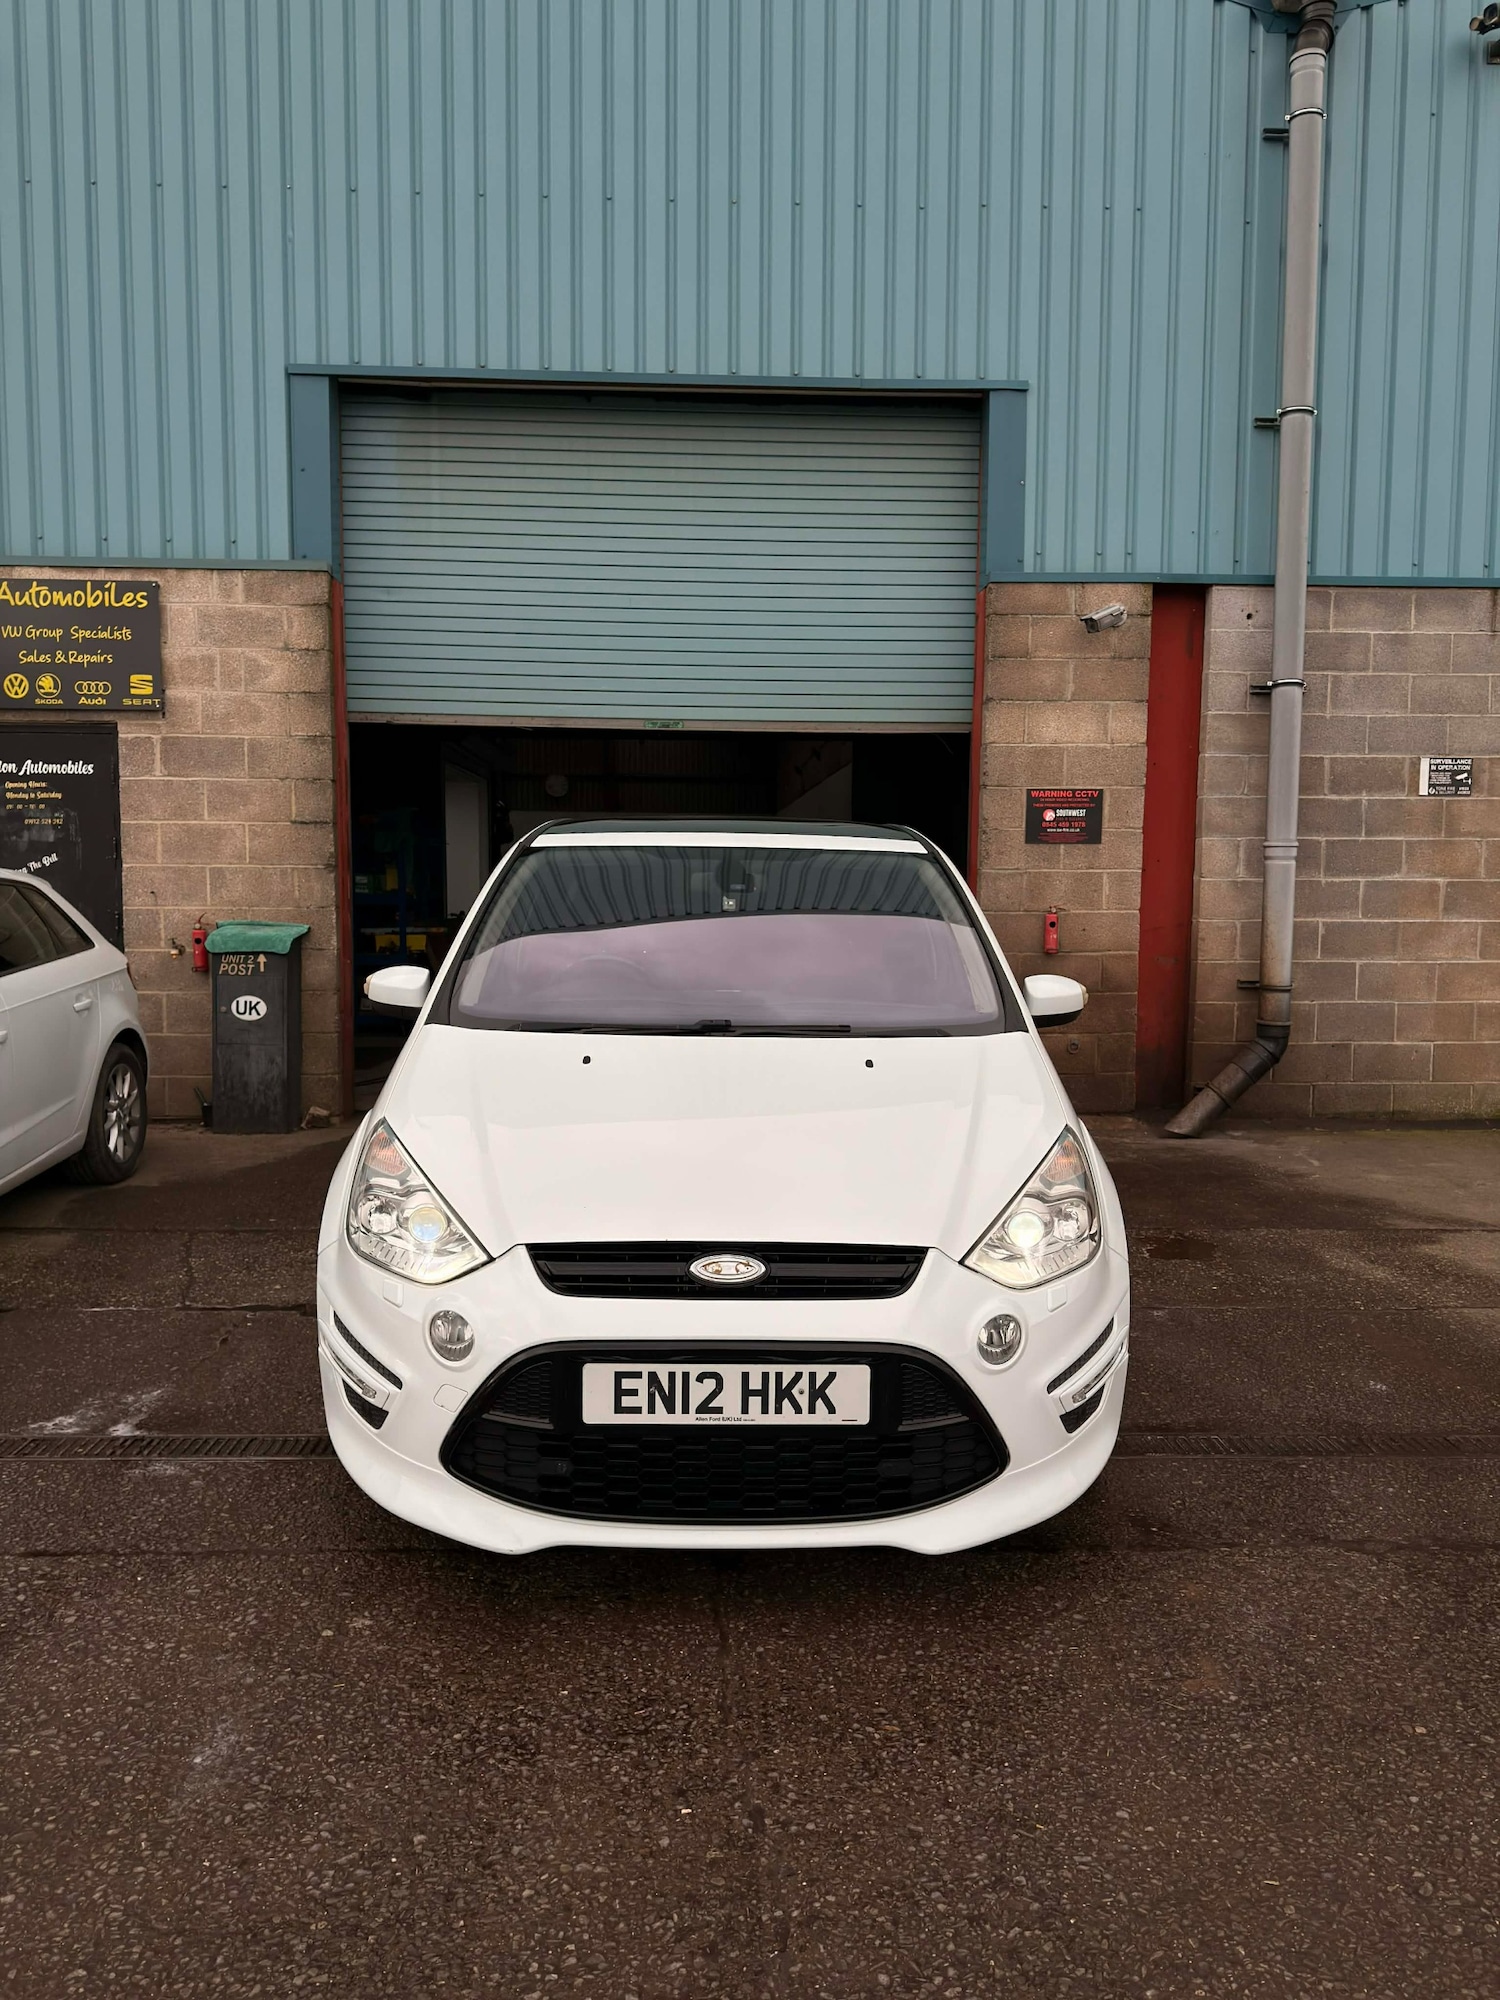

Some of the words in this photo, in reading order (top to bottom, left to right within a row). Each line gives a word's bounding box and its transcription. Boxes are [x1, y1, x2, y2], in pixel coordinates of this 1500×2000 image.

[0, 581, 148, 608] Automobiles
[1, 625, 23, 639] VW
[25, 625, 63, 642] Group
[70, 625, 132, 643] Specialists
[18, 650, 51, 664] Sales
[55, 650, 67, 663] &
[69, 650, 113, 668] Repairs
[78, 697, 106, 705] Audi
[122, 698, 161, 706] SEAT
[18, 759, 94, 776] Automobiles
[1030, 790, 1073, 798] WARNING
[1075, 790, 1099, 798] CCTV
[1056, 809, 1086, 817] SOUTHWEST
[27, 861, 42, 872] The
[42, 852, 58, 866] Bell
[221, 954, 245, 963] UNIT
[248, 955, 255, 964] 2
[219, 963, 255, 976] POST
[235, 1000, 261, 1016] UK
[613, 1371, 724, 1414] EN12
[741, 1371, 837, 1415] HKK
